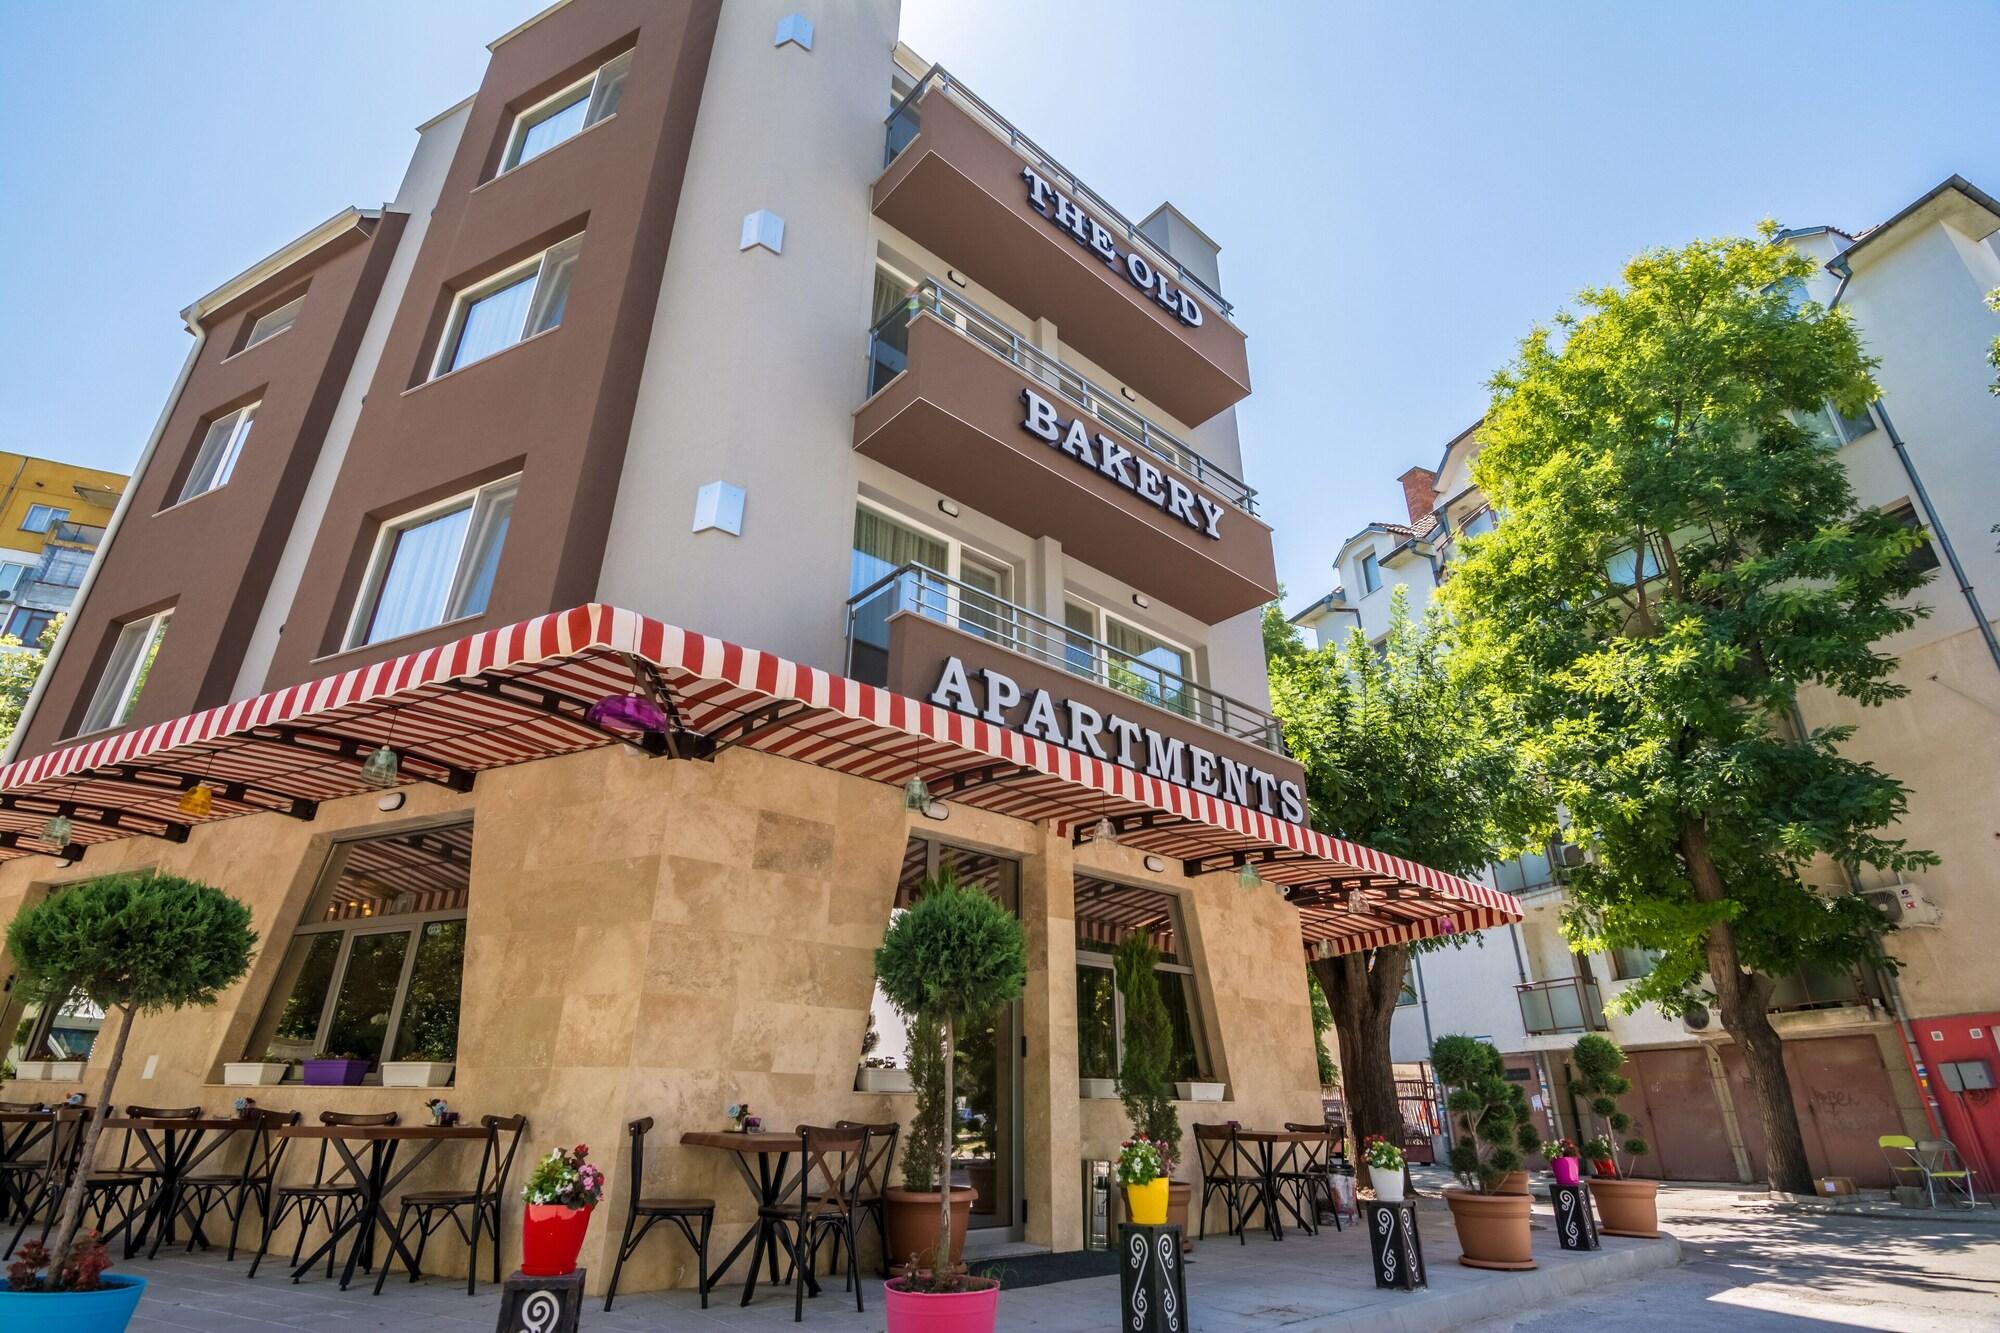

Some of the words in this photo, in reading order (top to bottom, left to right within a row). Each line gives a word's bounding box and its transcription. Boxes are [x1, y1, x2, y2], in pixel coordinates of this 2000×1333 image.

[1021, 165, 1116, 263] THE
[1126, 253, 1203, 328] OLD
[1021, 388, 1224, 540] BAKERY
[931, 656, 1304, 825] APARTMENTS
